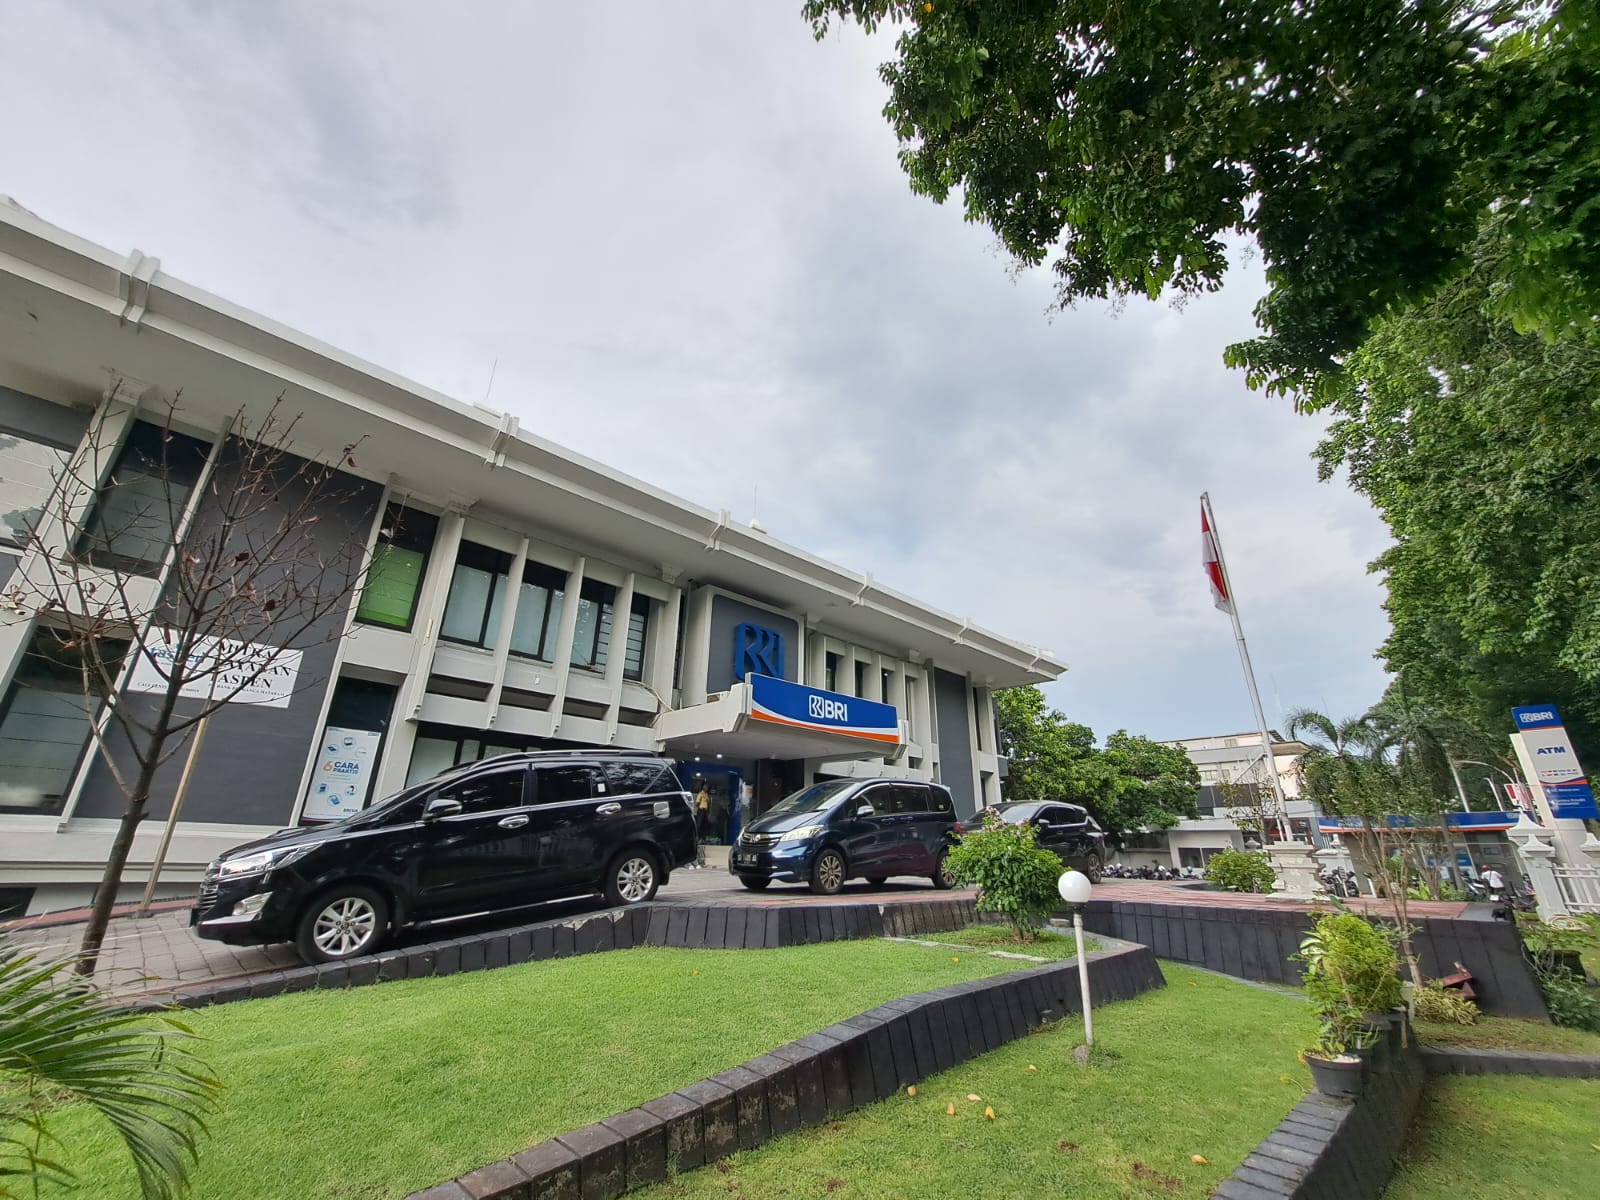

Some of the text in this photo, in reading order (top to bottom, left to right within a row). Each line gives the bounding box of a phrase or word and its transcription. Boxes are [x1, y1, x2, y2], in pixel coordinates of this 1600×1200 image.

[212, 657, 291, 677] AYAAN
[825, 700, 848, 722] BRI
[1536, 746, 1566, 755] ATM
[334, 761, 359, 769] CARA
